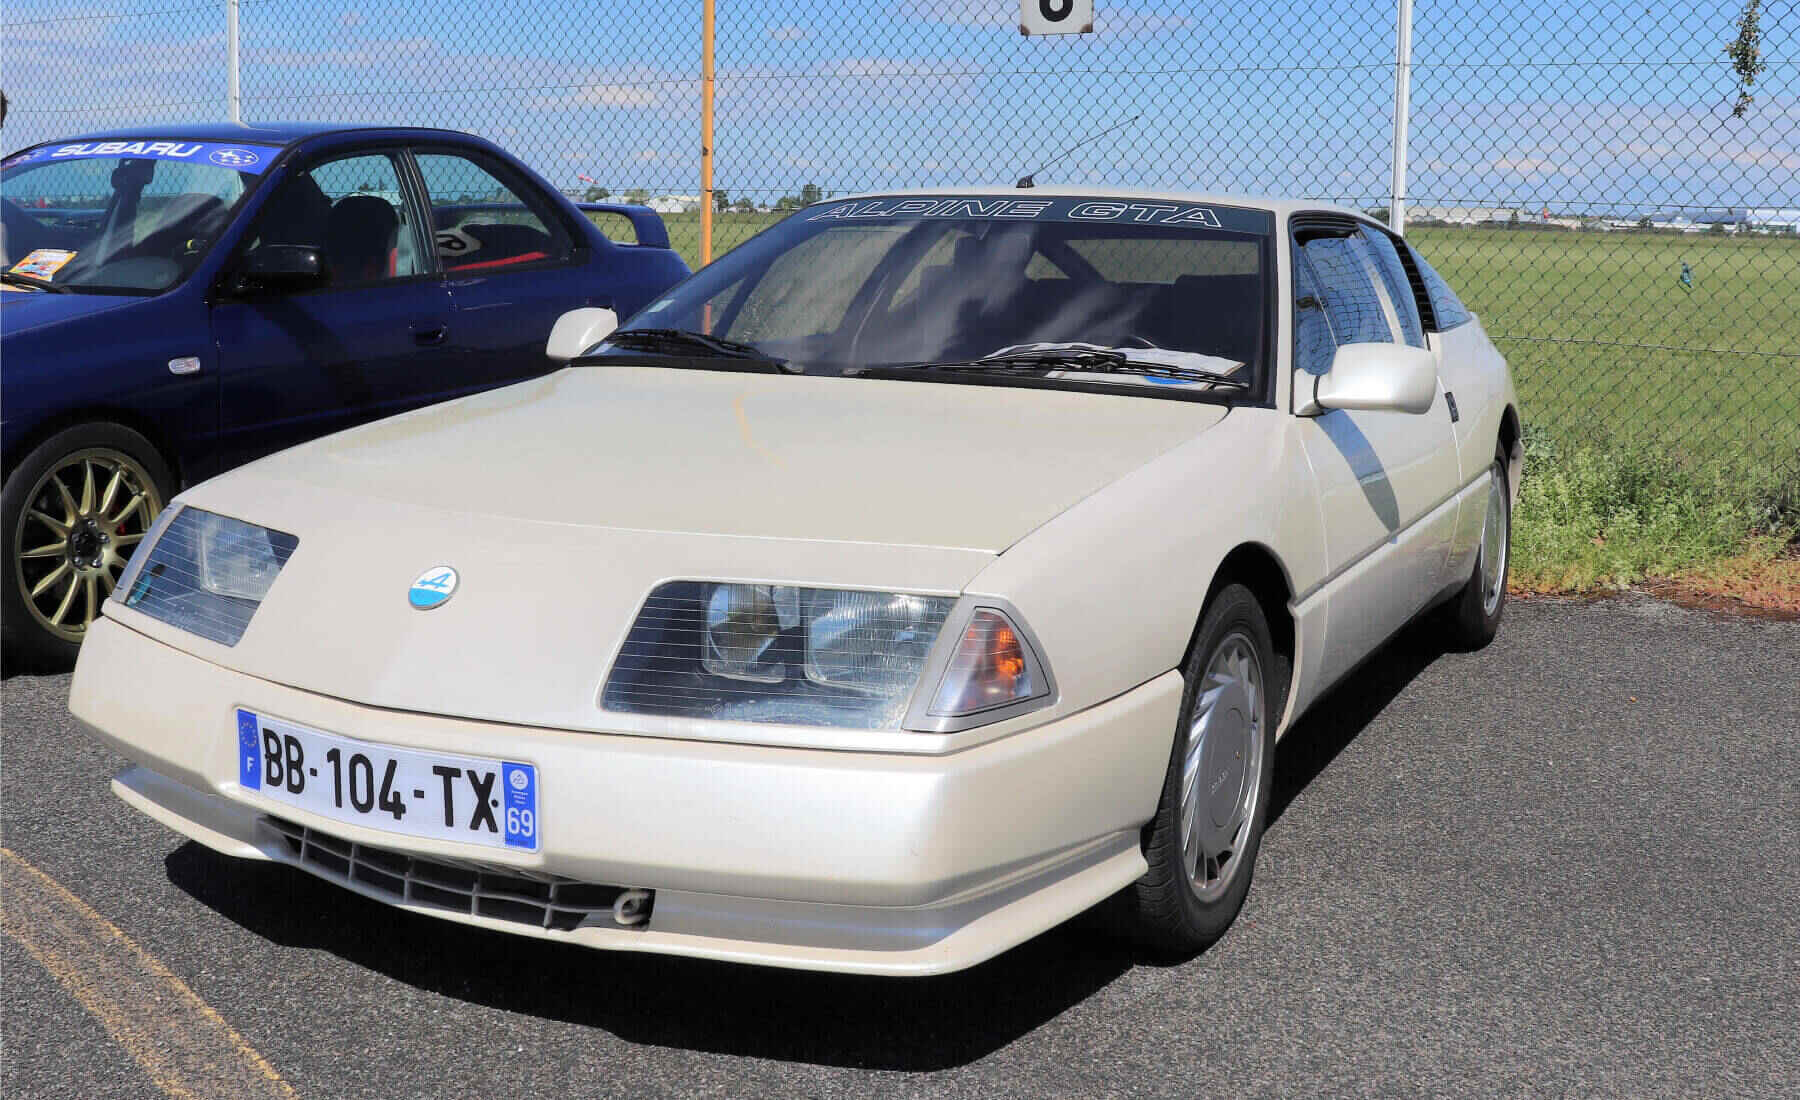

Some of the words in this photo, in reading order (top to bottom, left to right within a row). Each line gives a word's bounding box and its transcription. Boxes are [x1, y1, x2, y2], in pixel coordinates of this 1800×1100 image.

[51, 141, 202, 158] SUBARU
[807, 200, 1053, 222] ALPINE
[1067, 202, 1222, 228] GTA
[247, 756, 255, 773] F
[507, 807, 534, 837] 69
